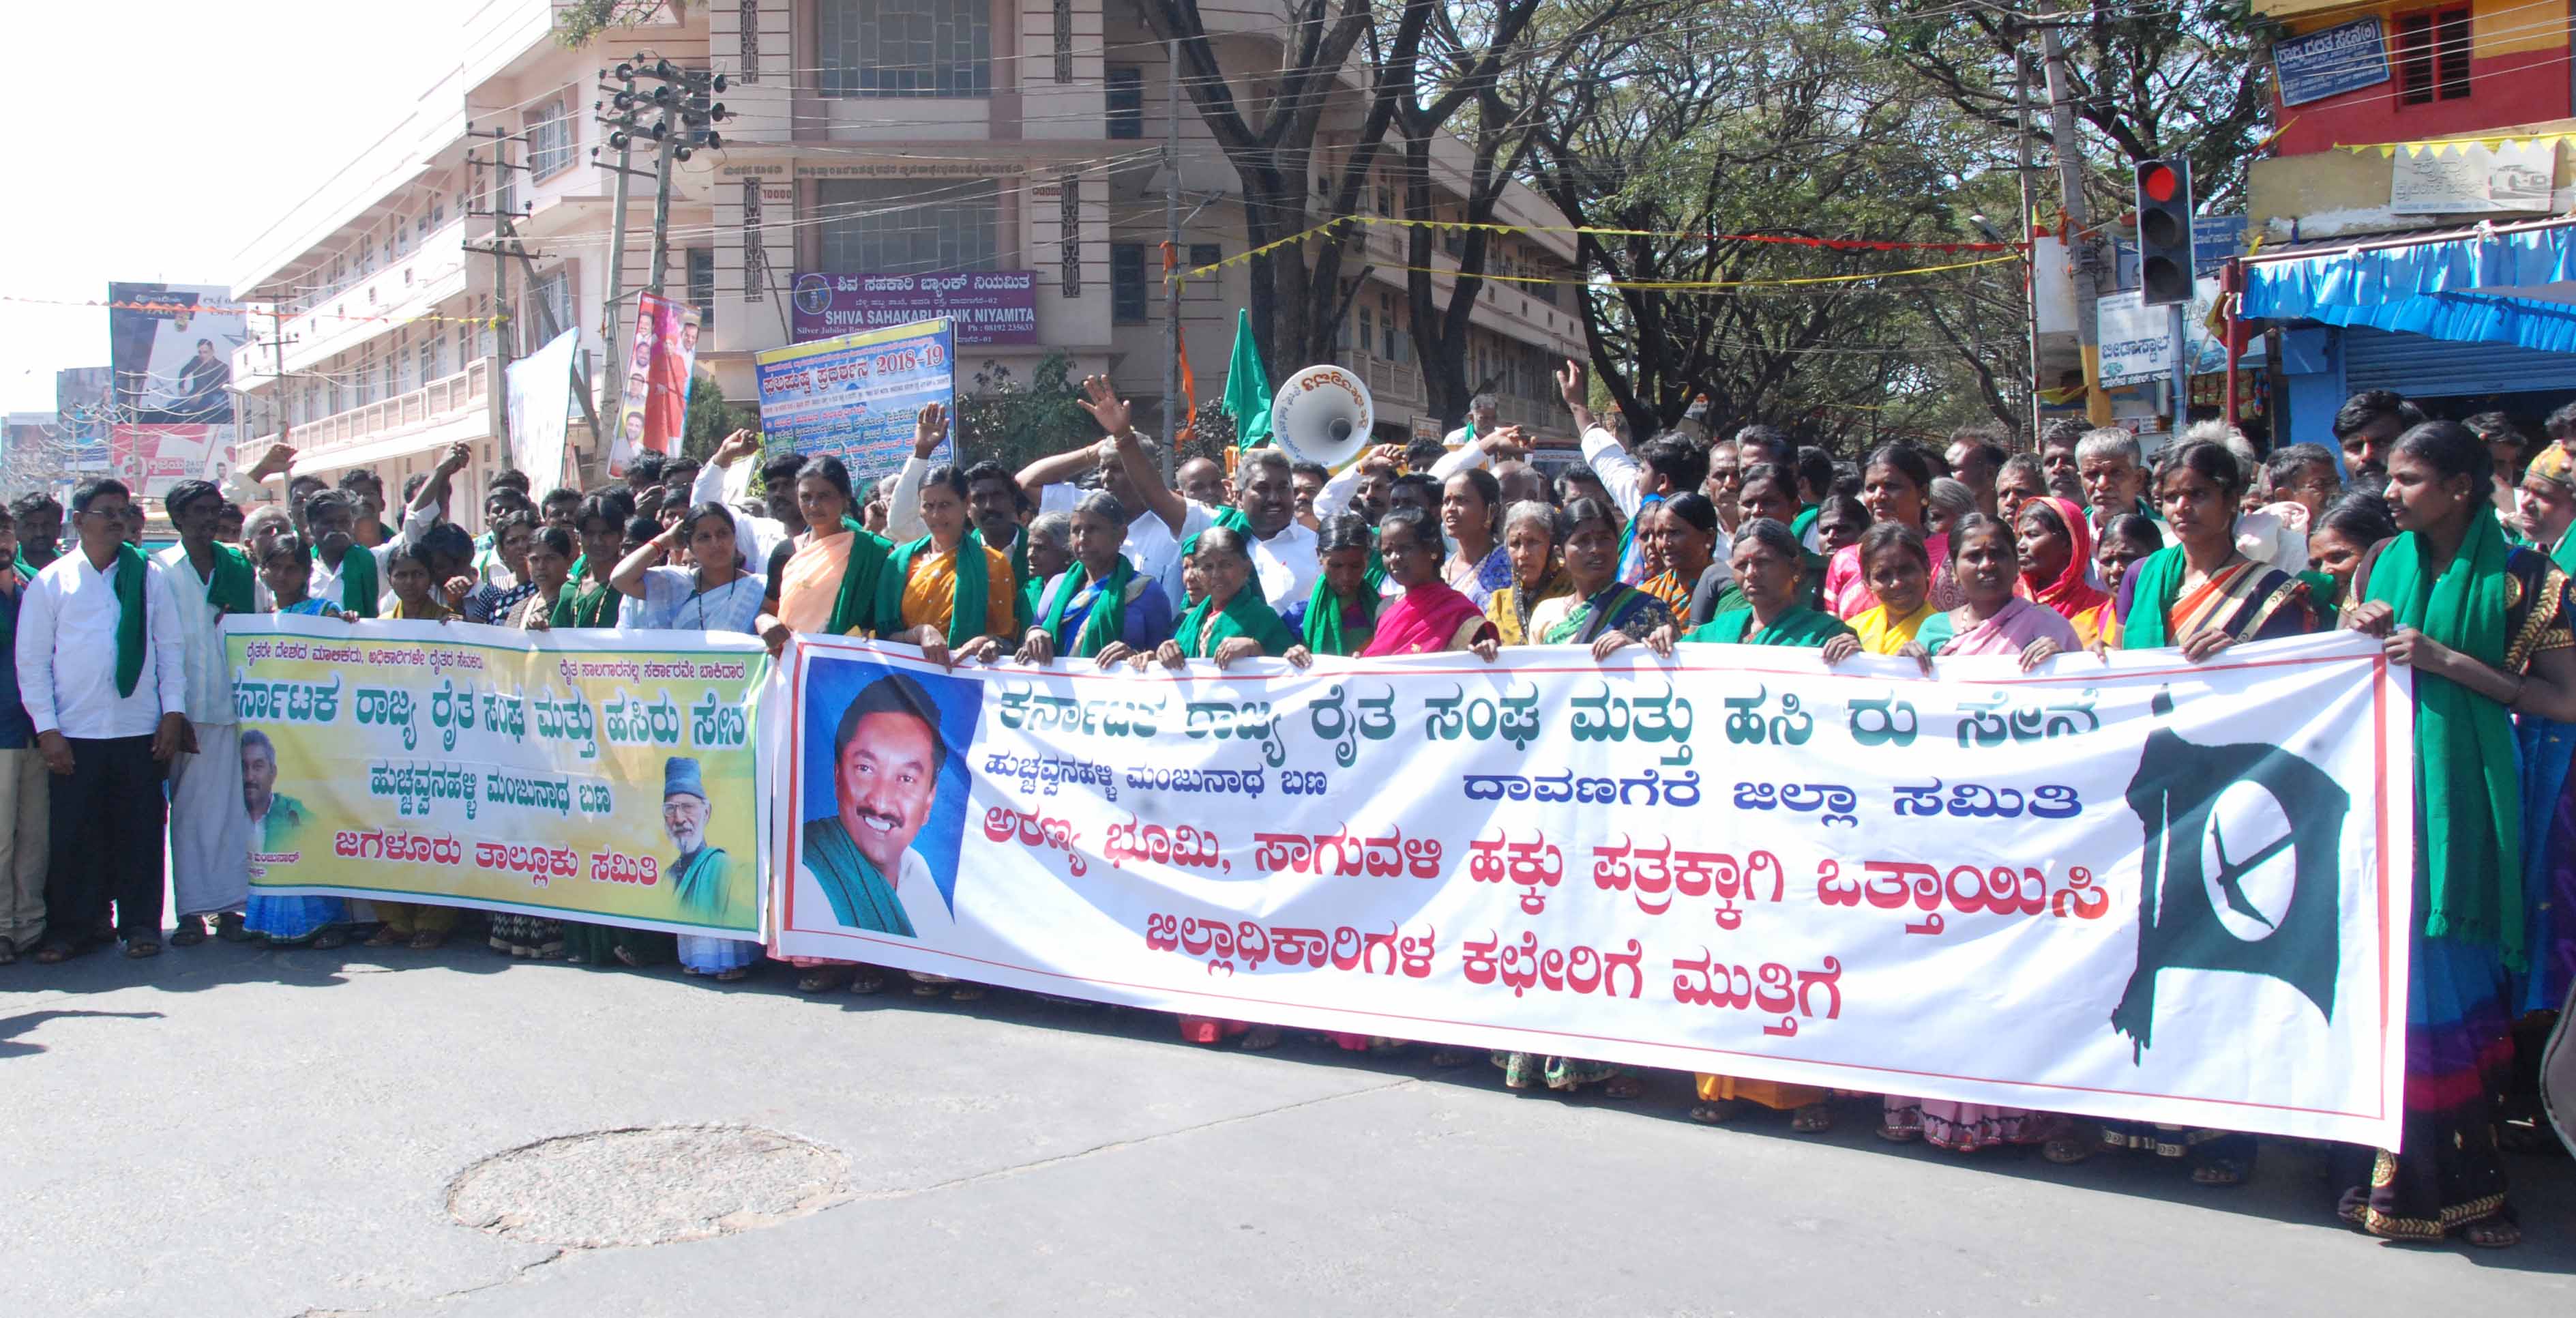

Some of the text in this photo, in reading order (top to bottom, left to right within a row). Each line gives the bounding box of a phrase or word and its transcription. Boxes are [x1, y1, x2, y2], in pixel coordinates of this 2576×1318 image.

[838, 274, 1030, 297] ಶಿವ ಸಹಕಾರಿ ಬ್ಯಾಂಕ್ ನಿಯಮಿತ
[825, 311, 863, 325] SHIVA
[867, 308, 933, 324] SAHAKARI
[975, 307, 1035, 322] NIYAMITA
[877, 346, 944, 375] 2018-19
[246, 641, 271, 666] ರೈತರೇ
[275, 641, 307, 660] ದೇಶದ
[430, 649, 454, 675] ರೈತರ
[560, 658, 578, 685] ರೈತ
[644, 659, 695, 679] ಸರ್ಕಾರವೇ
[699, 660, 745, 679] ಬಾಕಿದಾರ
[356, 689, 417, 751] ರಾಜ್ಯ
[432, 679, 475, 752] ರೈತ
[484, 686, 524, 744] ಸಂಘ
[535, 687, 595, 759] ಮತ್ತು
[606, 685, 679, 743] ಹಸಿರು
[999, 681, 1167, 739] ಕರ್ನಾಟಕ
[1185, 700, 1286, 767] ರಾಜ್ಯ
[1309, 684, 1397, 768] ರೈತ
[1425, 682, 1540, 752] ಸಂಘ
[1569, 681, 1693, 766] ಮತ್ತು
[370, 759, 611, 820] ಹುಚ್ಚವ್ವನಹಳ್ಳಿ ಮಂಜುನಾಥ ಬಣ
[984, 748, 2084, 828] ಹುಚ್ಚವ್ವನಹಳ್ಳಿ ಮಂಜುನಾಥ ಬಣ ದಾವಣಗೆರೆ ಜಿಲ್ಲಾ ಸಮಿತಿ
[336, 828, 659, 886] ಜಗಳೂರು ತಾಲ್ಲೂಕು ಸಮಿತಿ
[983, 804, 2110, 936] ಅರಣ್ಯ ಭೂಮಿ, ಸಾಗುವಳಿ ಹಕ್ಕು ಪತ್ರಕ್ಕಾಗಿ ಒತ್ತಾಯಿಸಿ
[1146, 911, 1842, 1038] ಜಿಲ್ಲಾಧಿಕಾರಿಗಳ ಕಛೇರಿಗೆ ಮುತ್ತಿಗೆ
